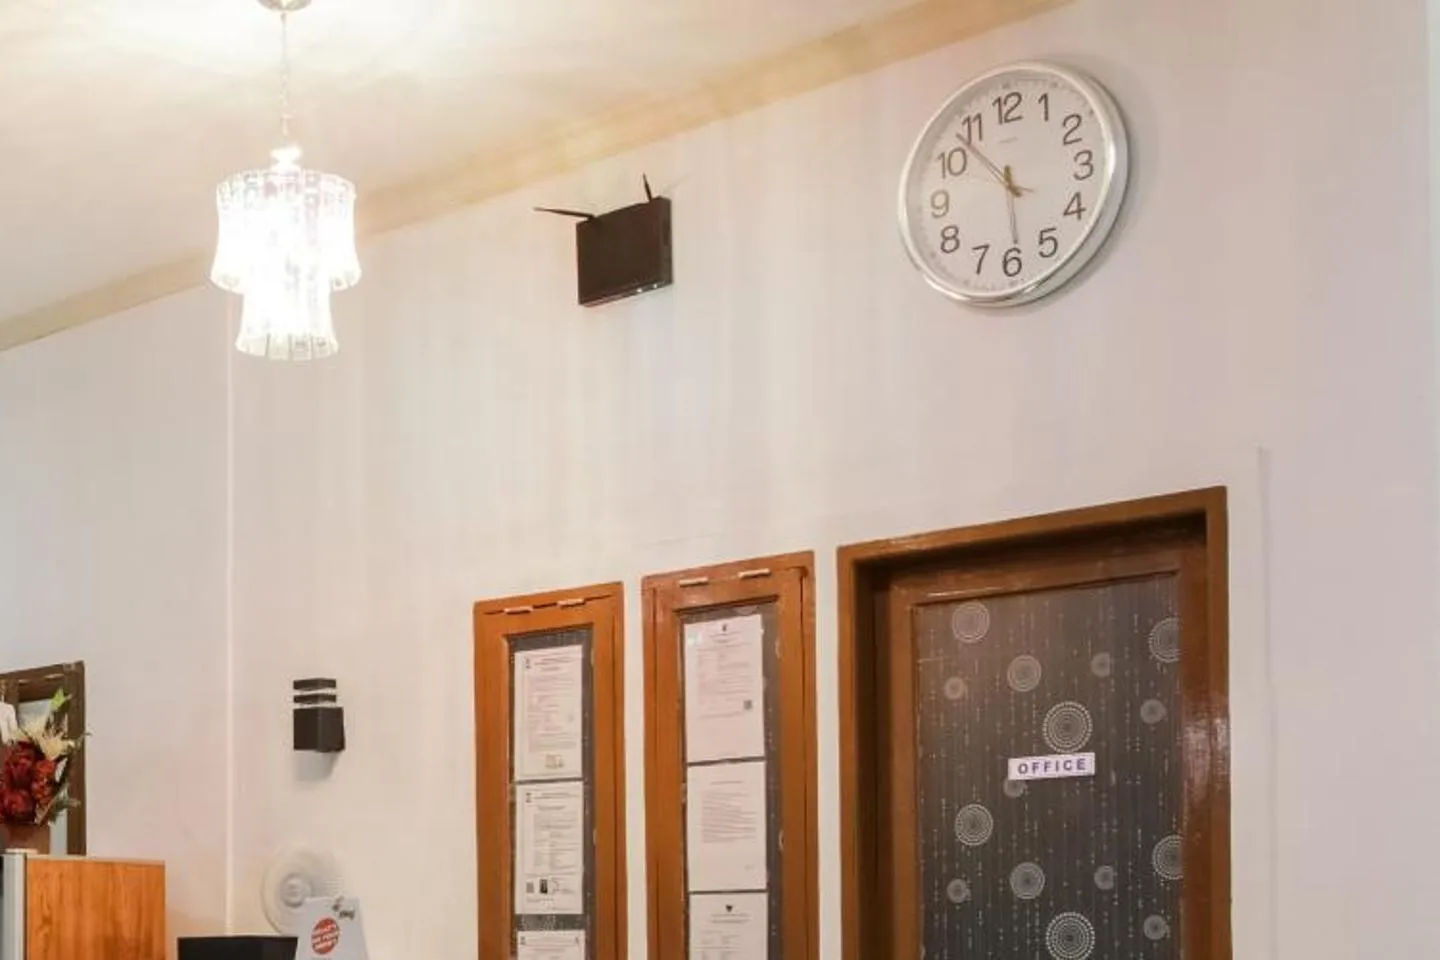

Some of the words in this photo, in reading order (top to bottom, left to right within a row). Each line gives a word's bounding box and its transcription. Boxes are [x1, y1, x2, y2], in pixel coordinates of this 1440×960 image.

[993, 92, 1023, 124] 12
[1038, 93, 1050, 121] 1
[962, 113, 983, 145] 11
[1062, 114, 1082, 145] 2
[937, 147, 968, 178] 10
[1073, 150, 1094, 180] 3
[930, 189, 950, 219] 9
[1063, 192, 1086, 220] 4
[940, 225, 960, 254] 8
[1038, 227, 1058, 258] 5
[972, 244, 990, 274] 7
[1002, 247, 1022, 277] 6
[1017, 758, 1086, 774] OFFICE
